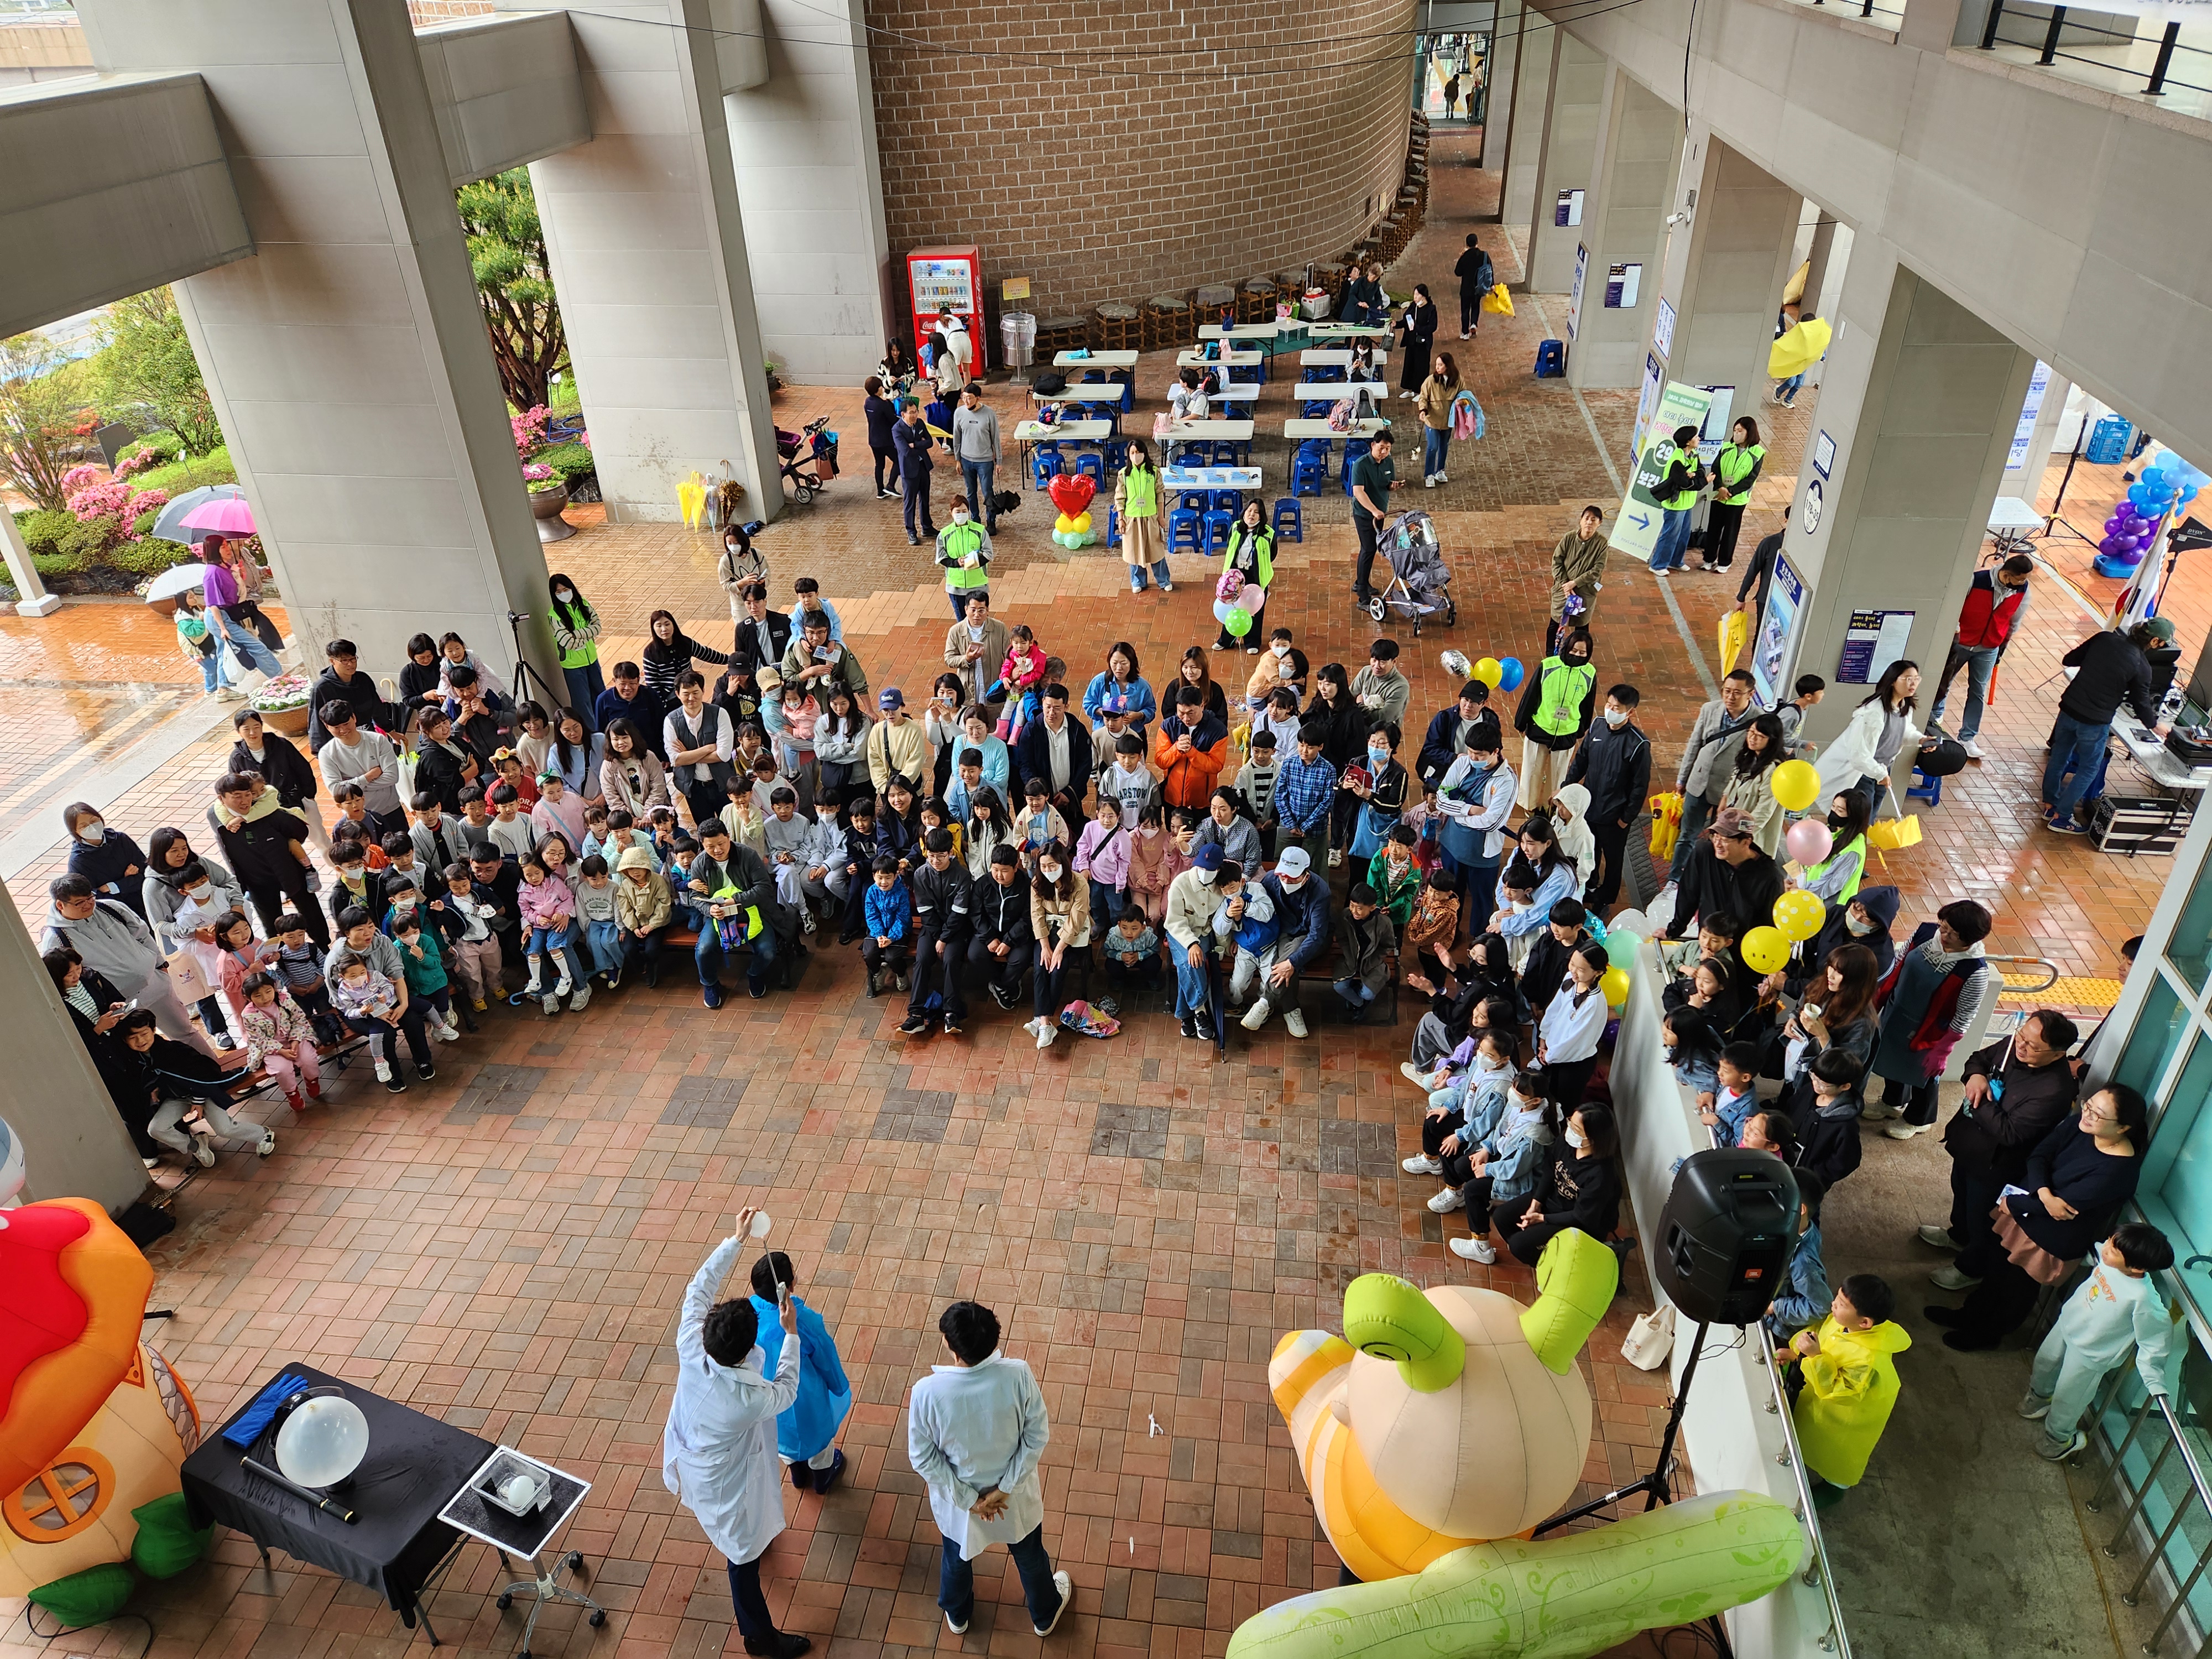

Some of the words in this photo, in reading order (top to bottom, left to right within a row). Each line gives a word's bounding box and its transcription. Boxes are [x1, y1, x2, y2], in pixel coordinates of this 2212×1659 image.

[1663, 410, 1677, 420] 아이
[1656, 444, 1674, 461] 29
[1806, 499, 1819, 521] 178-35
[1119, 787, 1148, 801] ARSTOW
